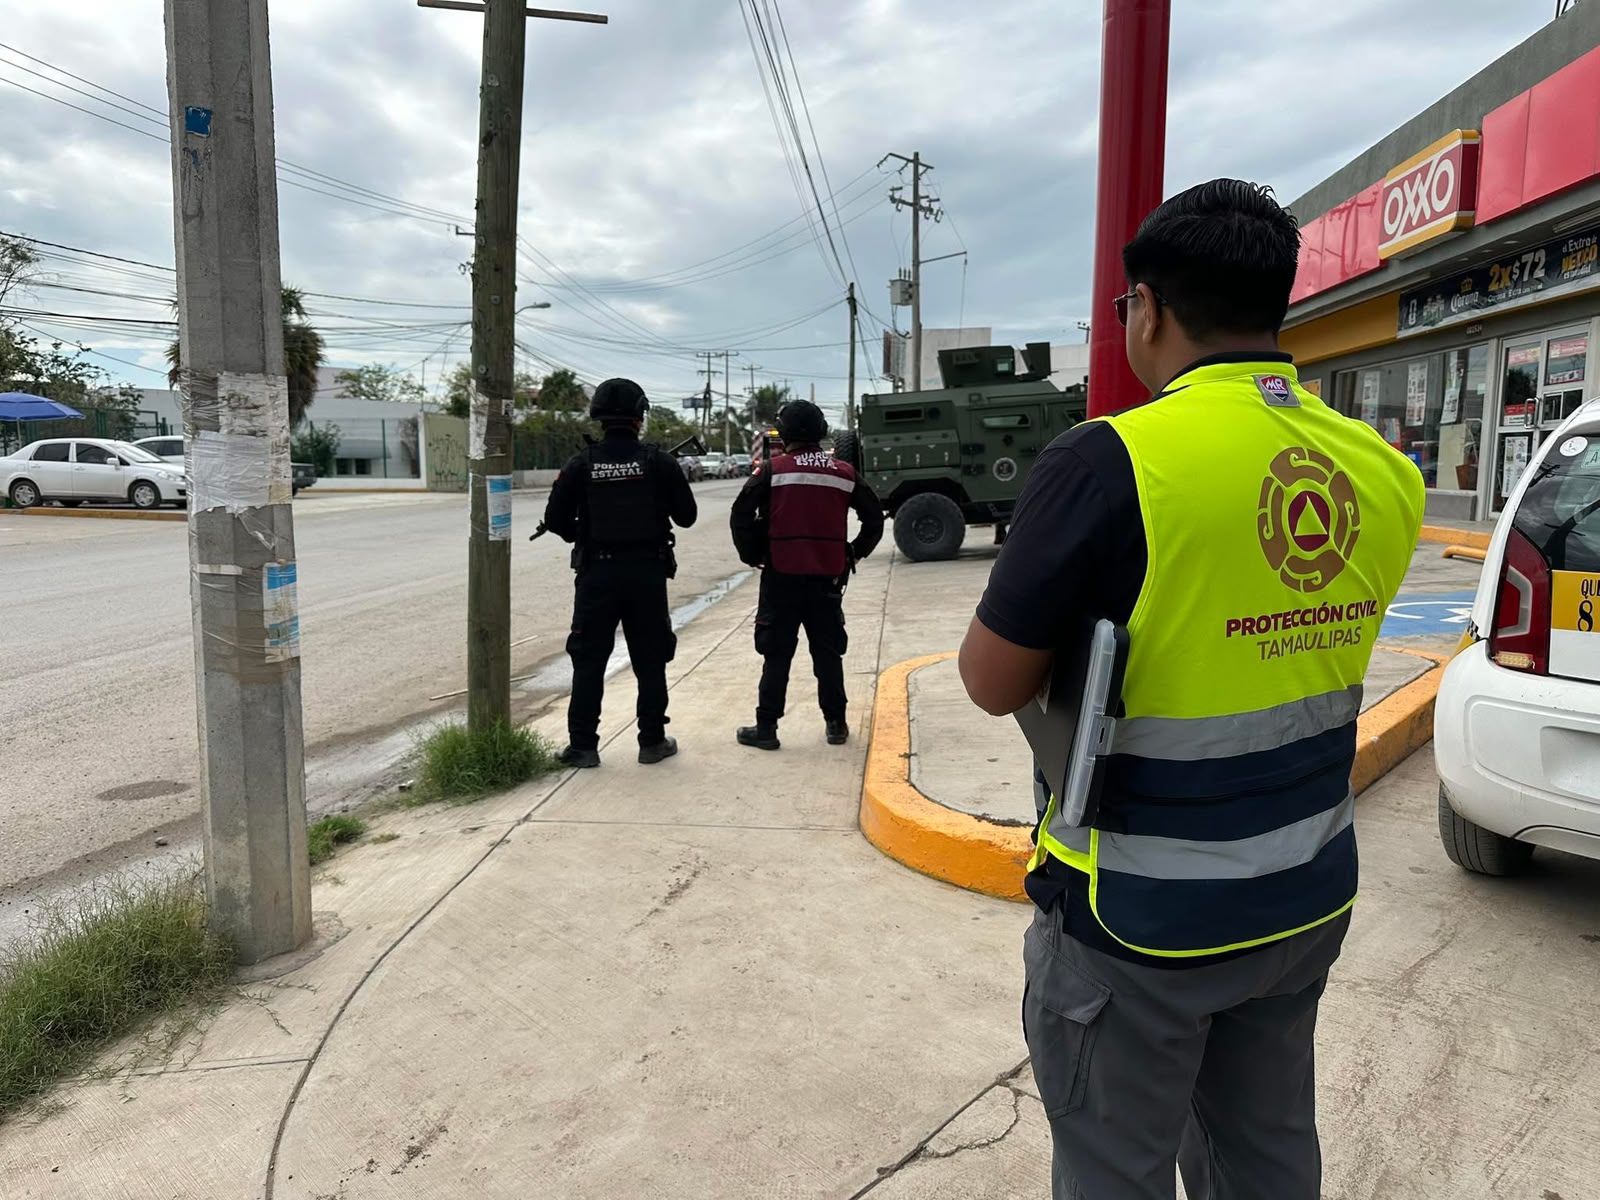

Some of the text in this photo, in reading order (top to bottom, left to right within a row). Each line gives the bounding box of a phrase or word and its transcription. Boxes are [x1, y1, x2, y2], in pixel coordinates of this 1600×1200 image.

[1383, 158, 1455, 238] OXXO
[1451, 291, 1479, 314] Corona
[1265, 378, 1286, 391] MR
[591, 467, 644, 479] ESTATAL
[1226, 600, 1378, 638] PROTECCIÓN CIVIL
[1577, 600, 1594, 632] 8
[1257, 626, 1362, 660] TAMAULIPAS
